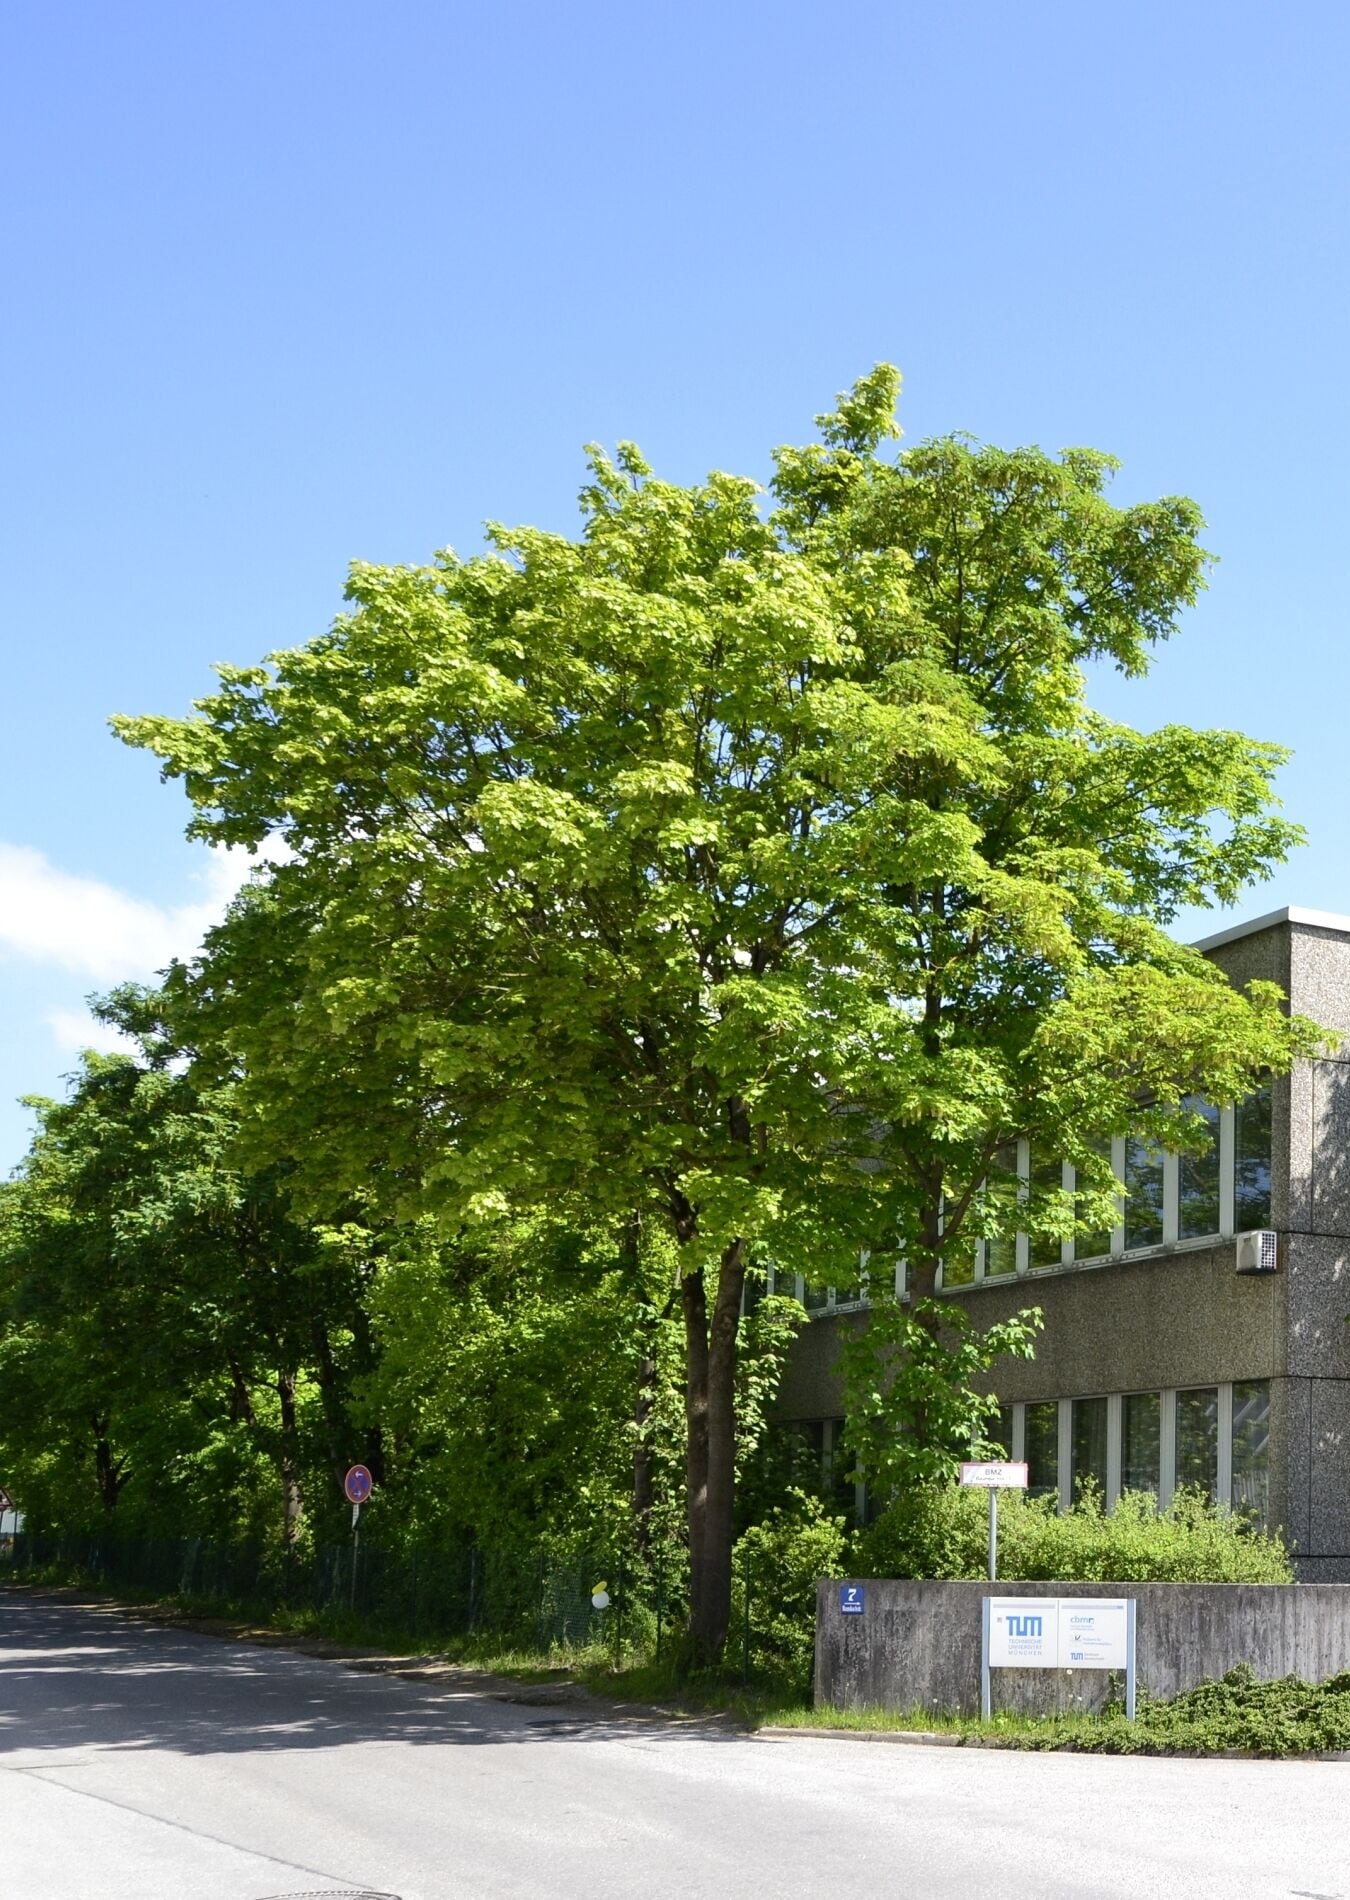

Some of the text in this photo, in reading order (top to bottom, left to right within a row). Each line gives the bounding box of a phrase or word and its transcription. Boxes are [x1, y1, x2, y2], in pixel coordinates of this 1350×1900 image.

[848, 1588, 857, 1602] 7
[1006, 1615, 1042, 1636] TUM
[1070, 1652, 1083, 1660] TUM
